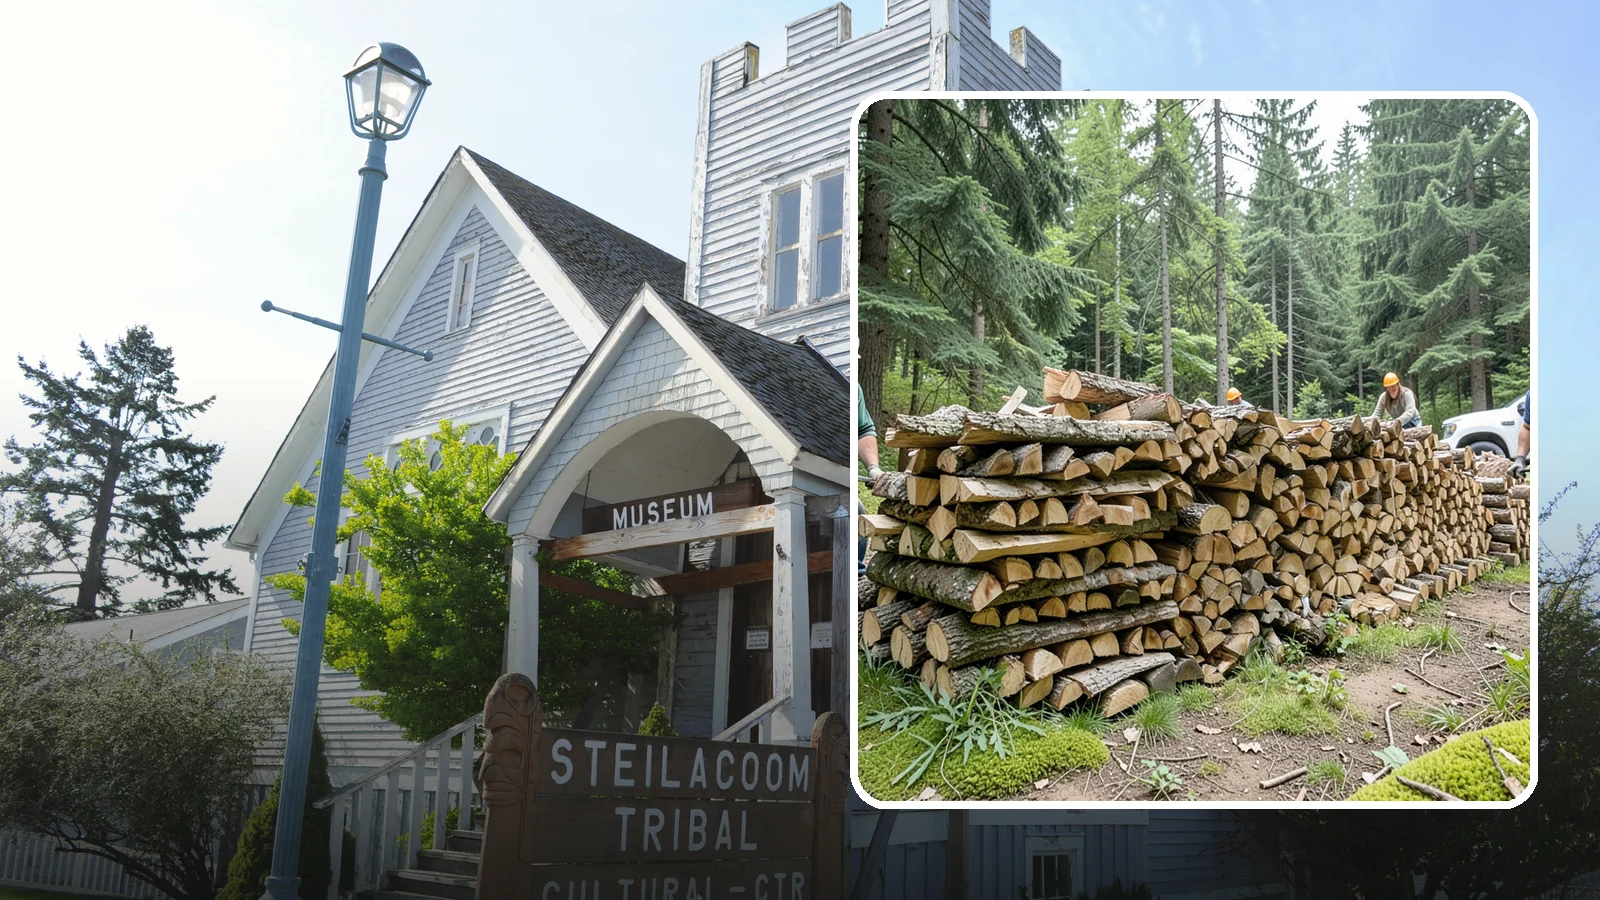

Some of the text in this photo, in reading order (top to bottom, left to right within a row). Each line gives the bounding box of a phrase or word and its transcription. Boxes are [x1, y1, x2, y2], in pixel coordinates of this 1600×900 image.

[613, 491, 714, 531] MUSEUM
[550, 738, 810, 792] STEILACOOM
[614, 806, 758, 852] TRIBAL
